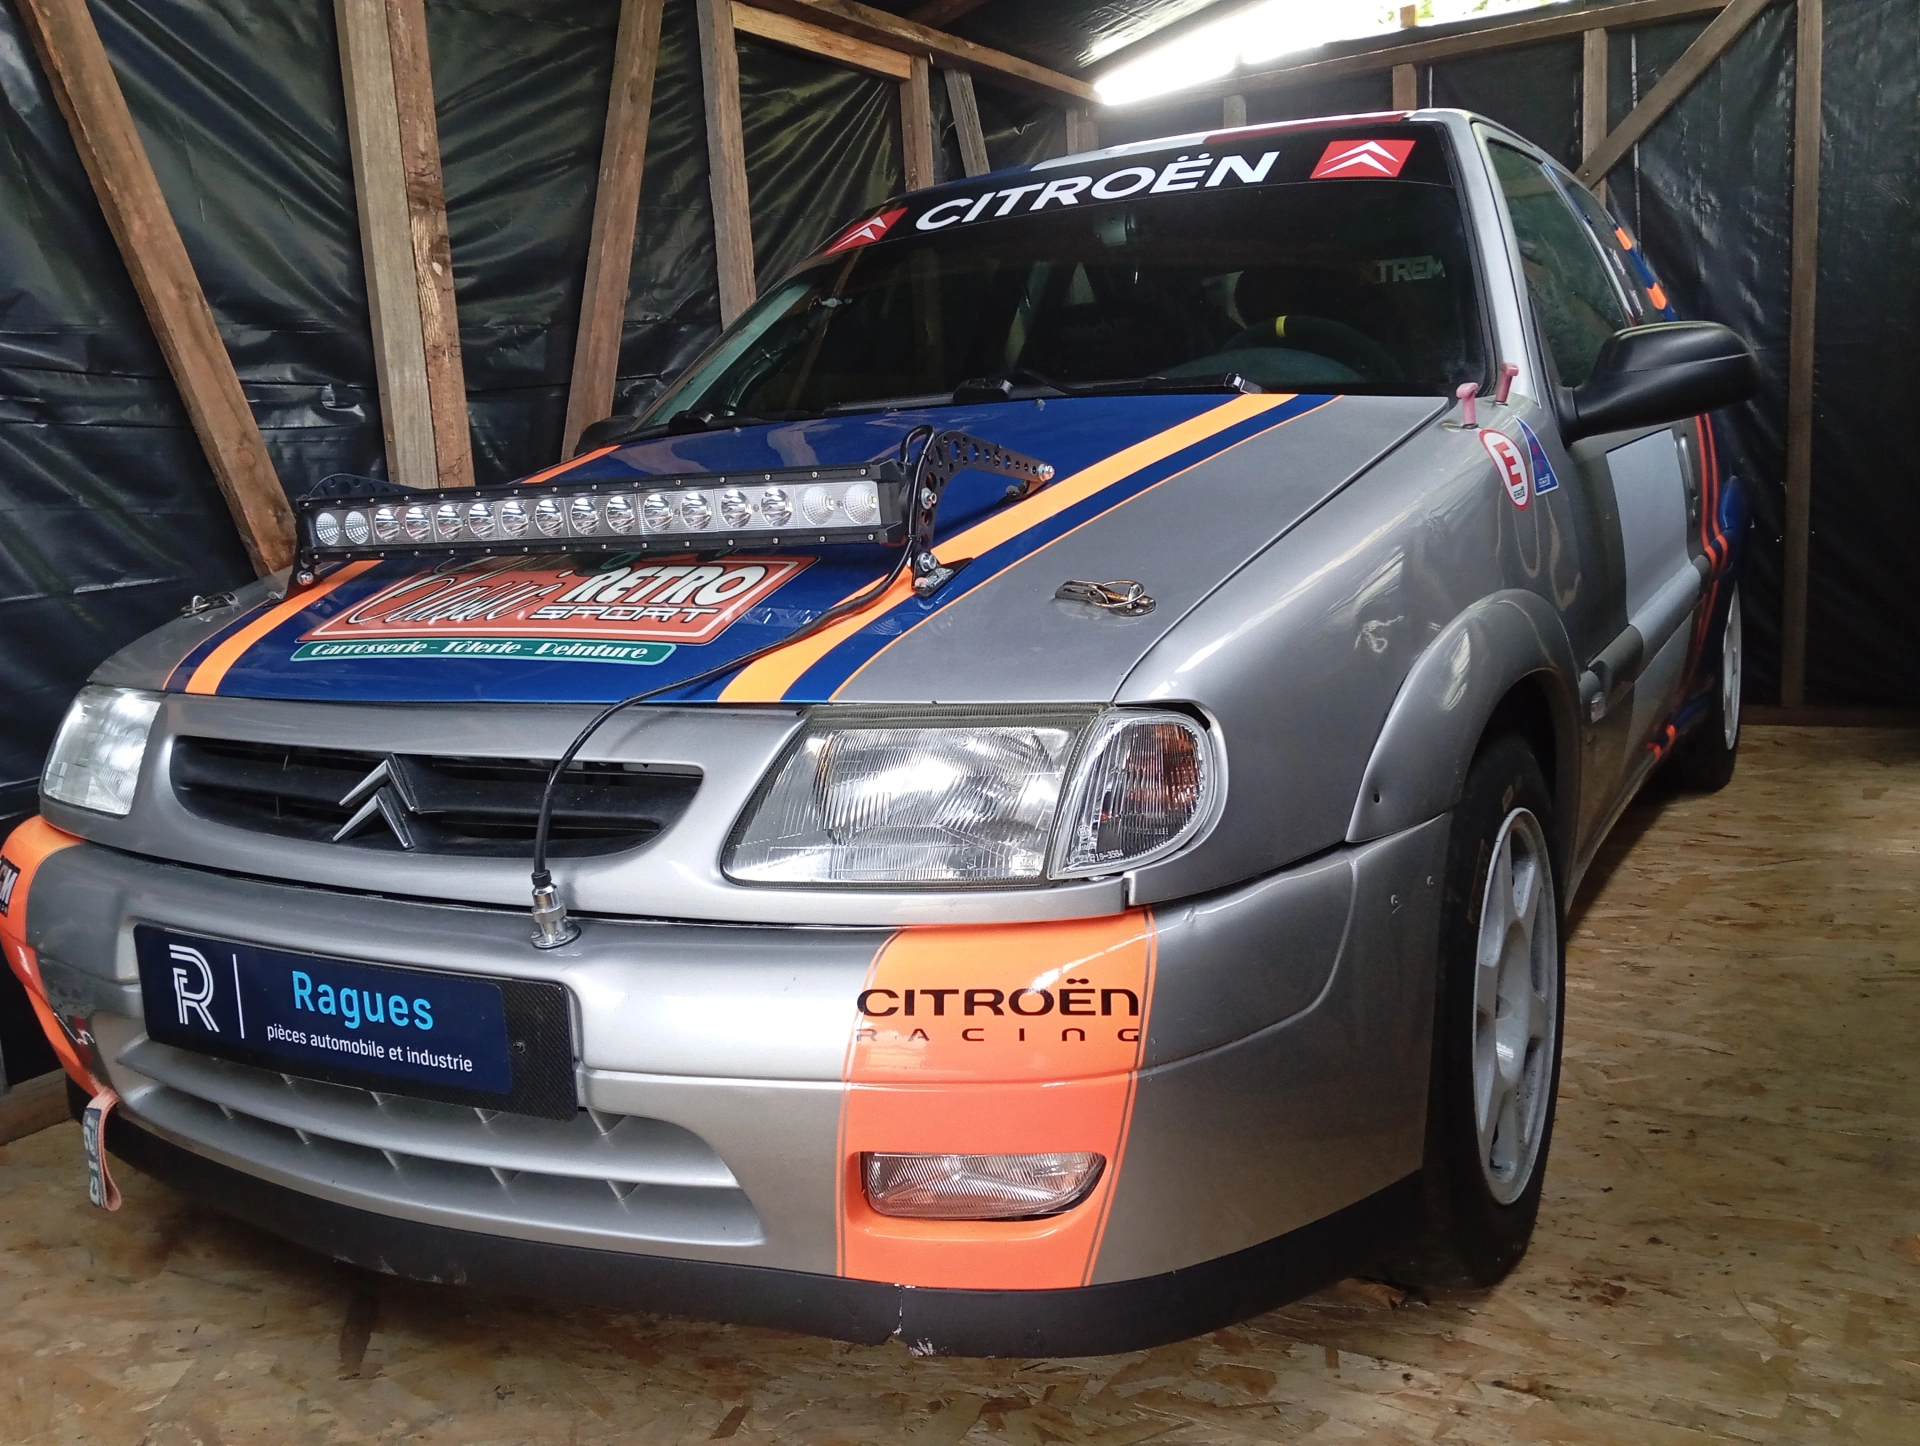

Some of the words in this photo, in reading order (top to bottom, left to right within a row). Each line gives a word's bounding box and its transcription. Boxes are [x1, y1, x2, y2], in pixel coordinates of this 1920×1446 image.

[915, 150, 1280, 232] CITROËN
[556, 566, 766, 606] RETRO
[529, 606, 719, 623] SPORT
[311, 641, 427, 657] Carrosserie
[441, 640, 521, 656] Tôlerie
[535, 641, 648, 659] Peinture
[292, 970, 434, 1030] Ragues
[856, 978, 1140, 1017] CITROËN
[266, 1024, 307, 1044] pièces
[310, 1034, 385, 1059] automobile
[388, 1046, 403, 1062] et
[406, 1046, 473, 1072] industrie
[856, 1027, 1140, 1042] RACING
